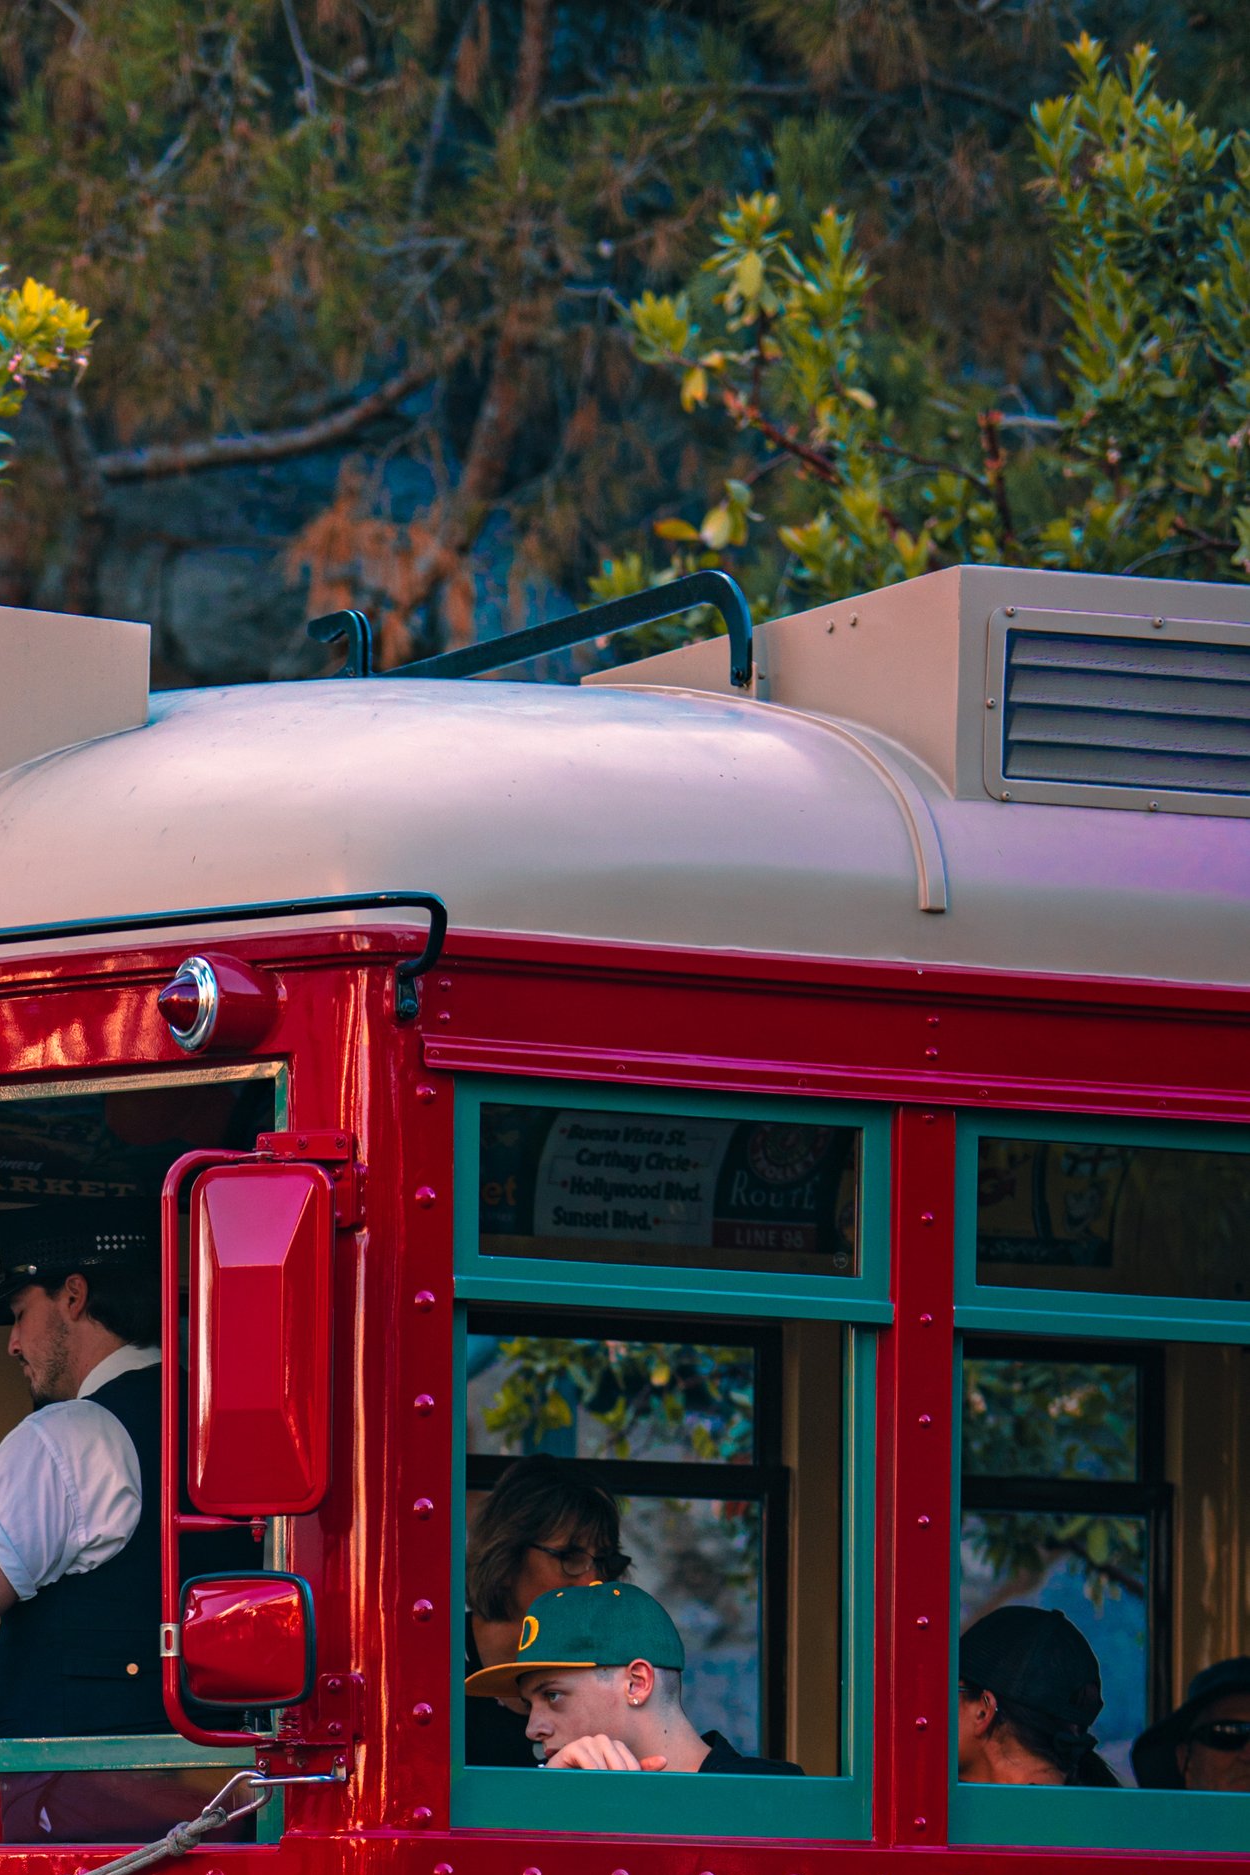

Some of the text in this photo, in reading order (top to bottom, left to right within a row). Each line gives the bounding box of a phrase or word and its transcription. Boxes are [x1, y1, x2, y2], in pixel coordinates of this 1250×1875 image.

[566, 1123, 686, 1146] Buena Vista St.
[576, 1148, 691, 1174] Carthay Circle
[570, 1176, 702, 1202] Hollywood Blvd.
[553, 1206, 652, 1230] Sunset Blvd.
[735, 1227, 777, 1248] LINE
